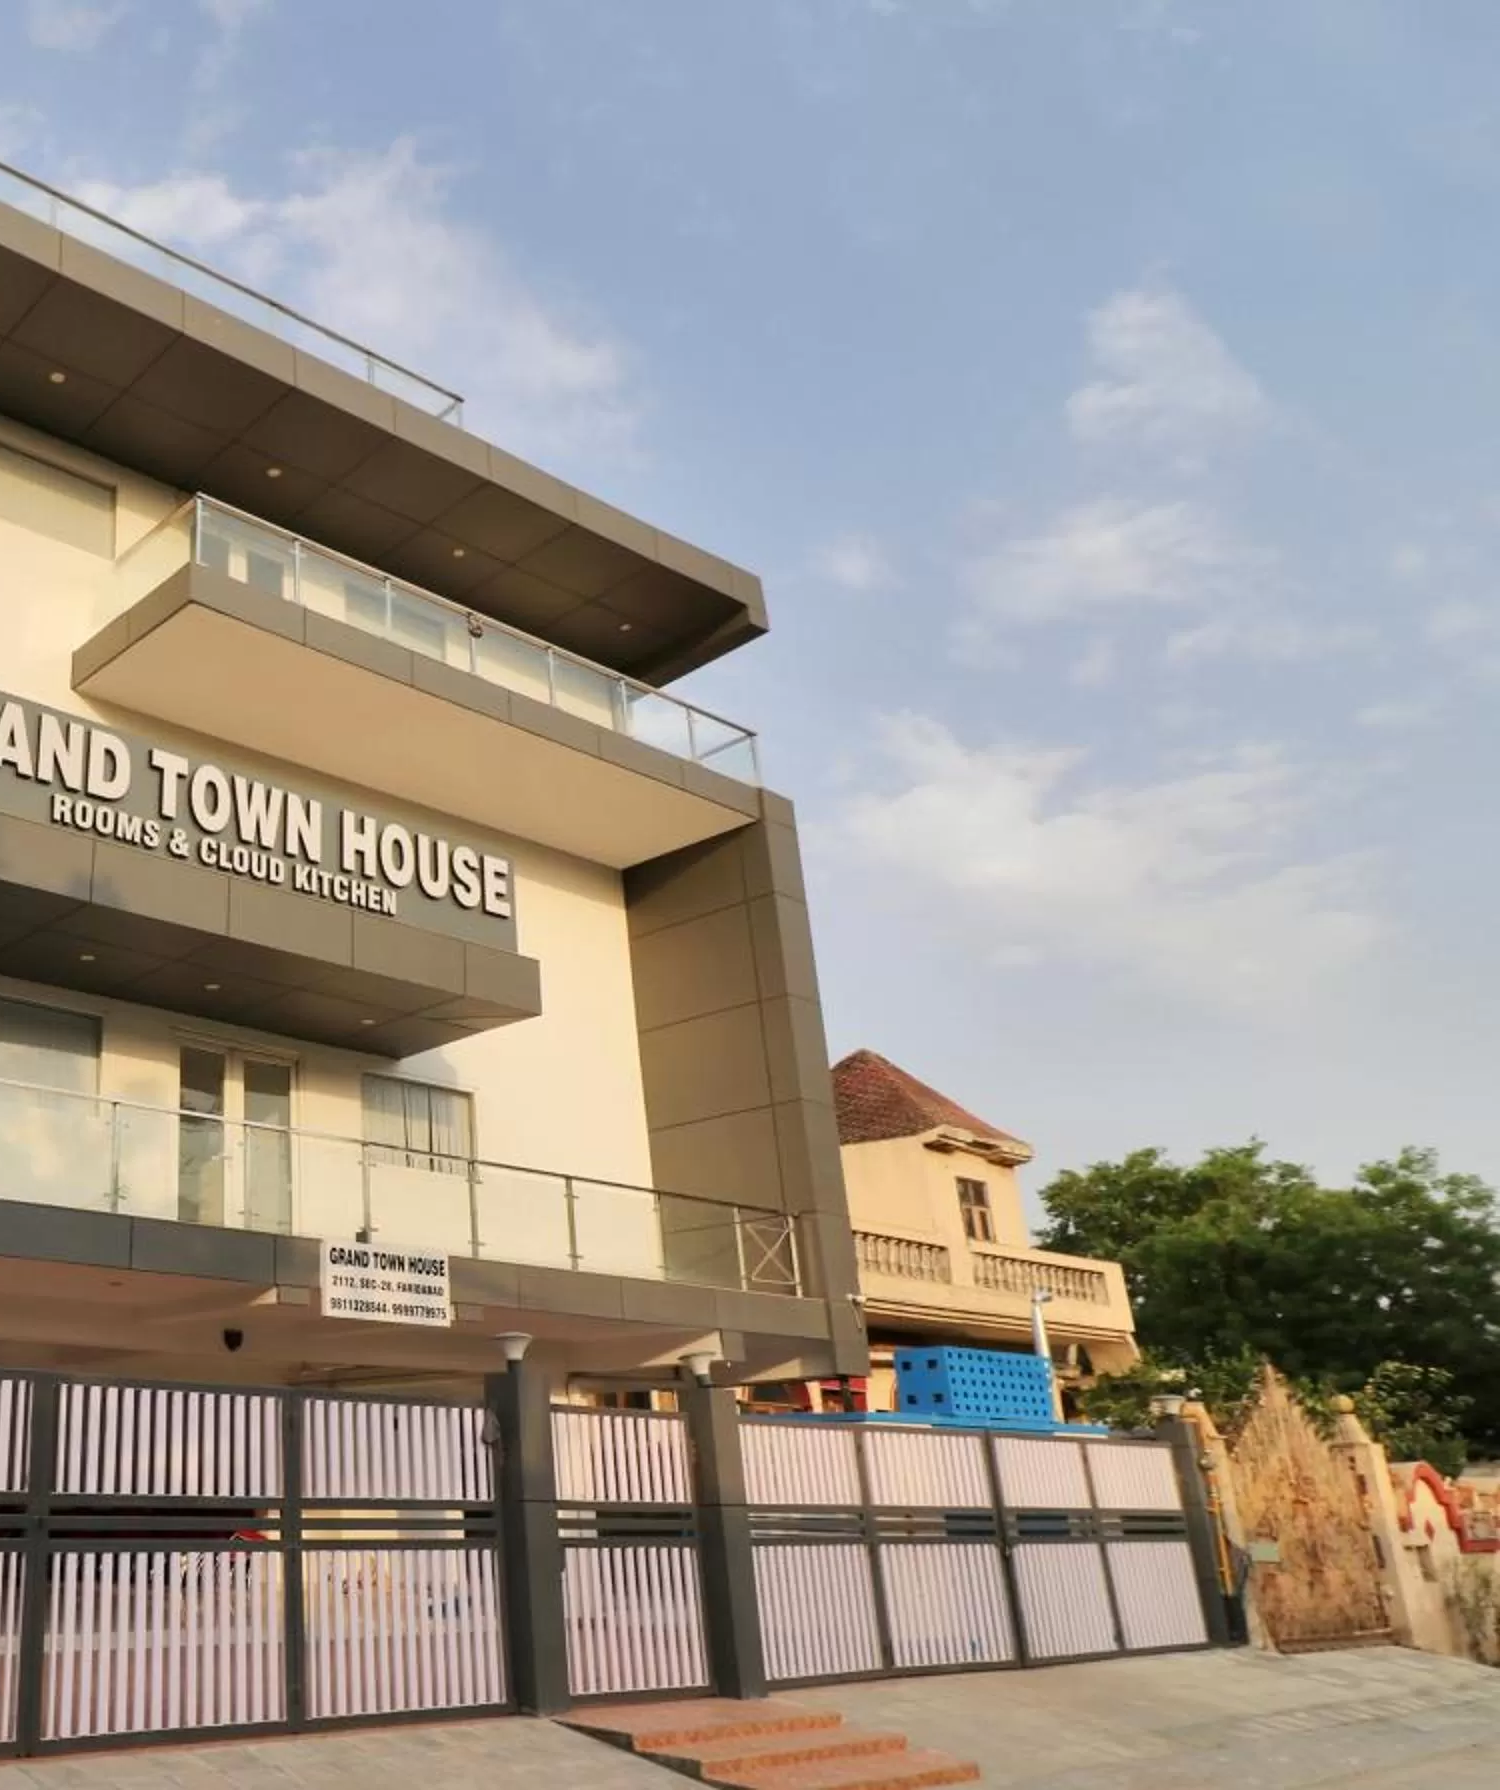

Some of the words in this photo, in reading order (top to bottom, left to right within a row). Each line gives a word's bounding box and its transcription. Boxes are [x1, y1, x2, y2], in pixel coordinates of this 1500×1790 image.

[52, 793, 160, 849] ROOMS
[168, 828, 190, 859] &
[199, 837, 286, 884] CLOUD
[292, 863, 397, 916] KITCHEN
[149, 748, 323, 863] TOWN
[341, 808, 512, 919] HOUSE
[329, 1247, 370, 1268] GRAND
[373, 1252, 405, 1272] TOWN
[408, 1256, 445, 1277] HOUSE
